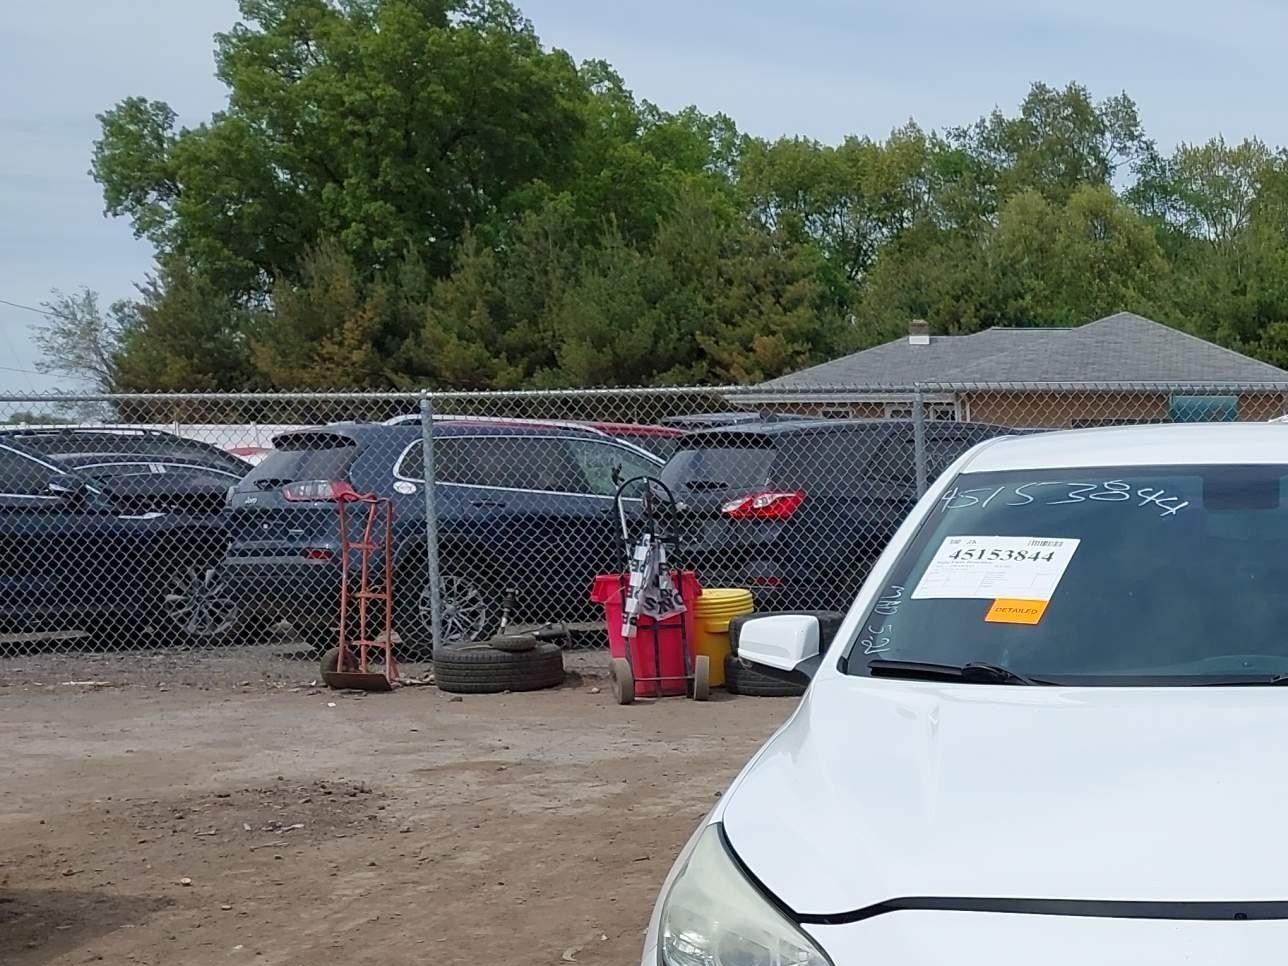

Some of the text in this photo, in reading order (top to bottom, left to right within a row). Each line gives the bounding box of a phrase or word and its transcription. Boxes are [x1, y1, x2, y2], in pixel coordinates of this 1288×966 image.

[941, 479, 1189, 517] 45153844
[949, 548, 1055, 562] 45153844
[994, 607, 1038, 615] DETAILED
